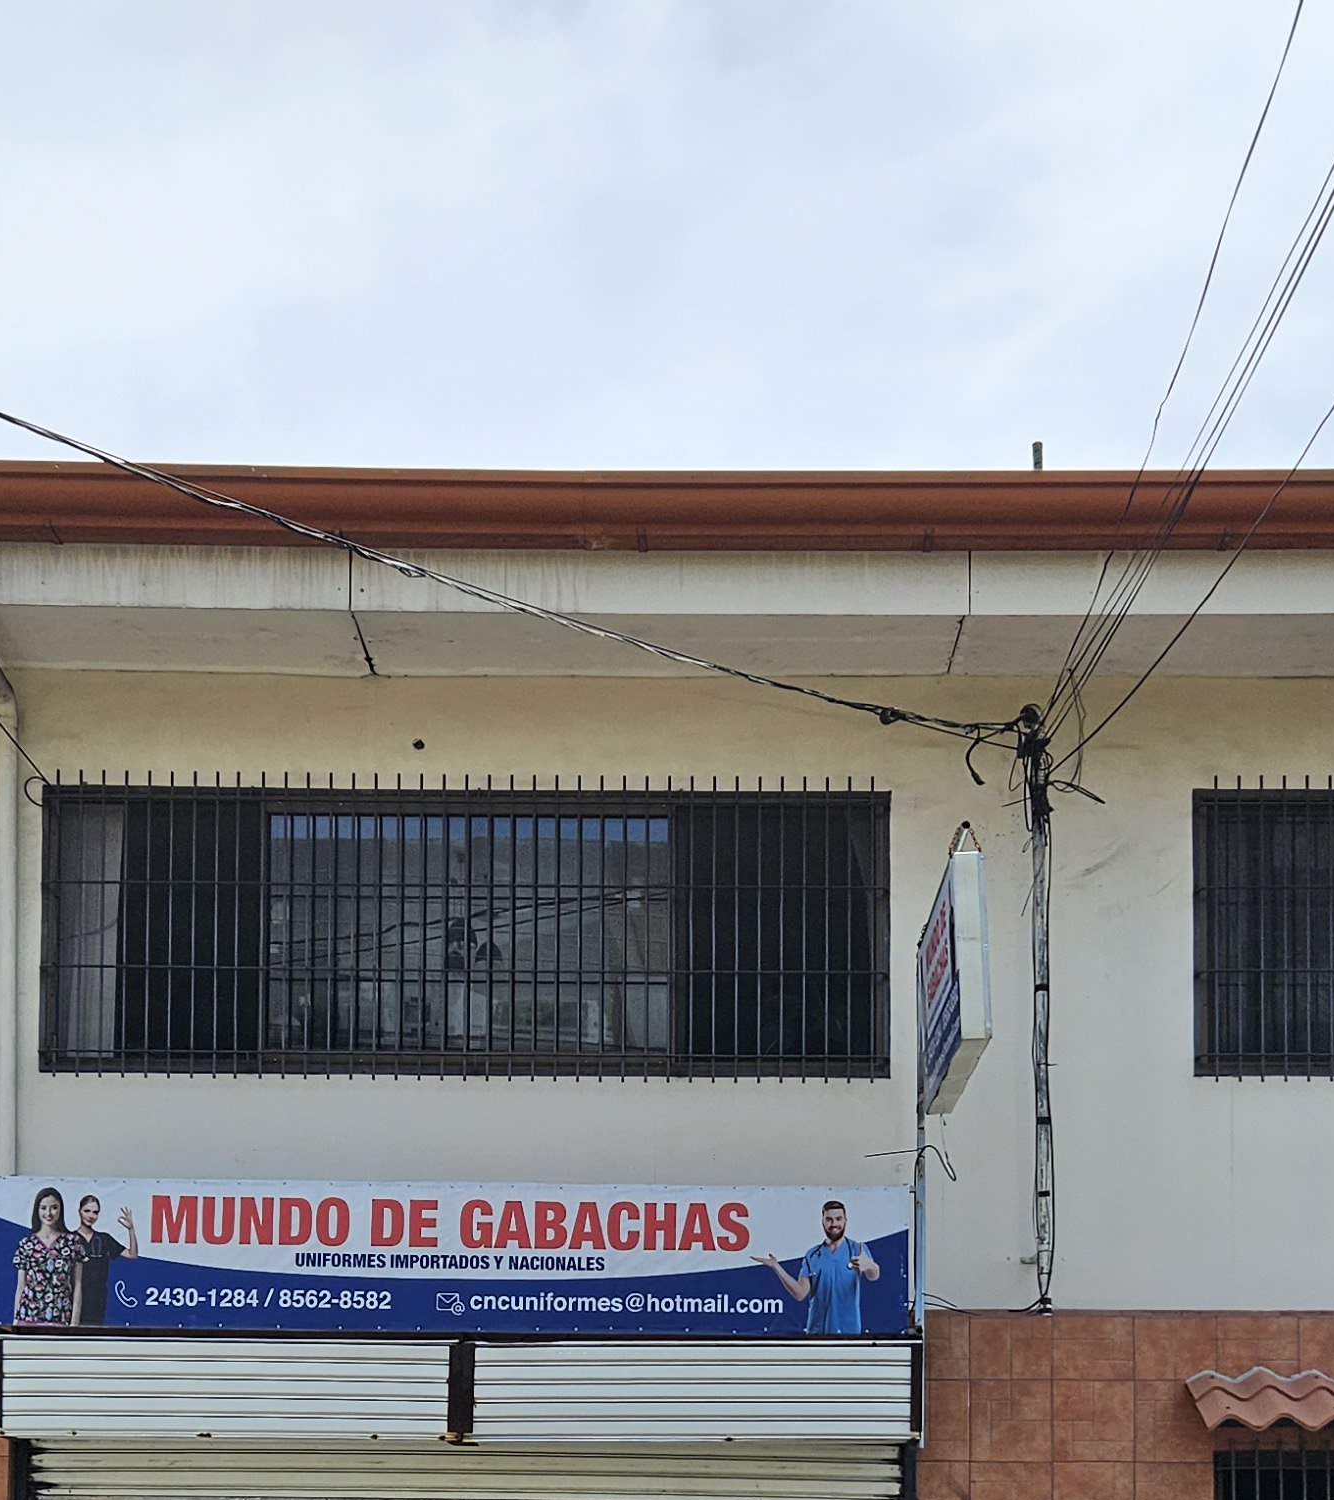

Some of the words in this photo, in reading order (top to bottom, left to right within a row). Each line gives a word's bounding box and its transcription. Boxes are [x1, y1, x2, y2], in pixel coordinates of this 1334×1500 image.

[150, 1194, 351, 1247] MUNDO
[370, 1198, 438, 1248] DE
[459, 1199, 750, 1252] GABACHAS
[295, 1252, 386, 1269] UNIFORMES
[390, 1253, 490, 1271] IMPORTADOS
[495, 1255, 504, 1270] Y
[508, 1255, 605, 1272] NACIONALES
[145, 1287, 259, 1307] 2430-1284
[263, 1287, 275, 1308] /
[278, 1288, 392, 1310] 8562-8582
[469, 1292, 784, 1314] cncuniformes@hotmail.com
